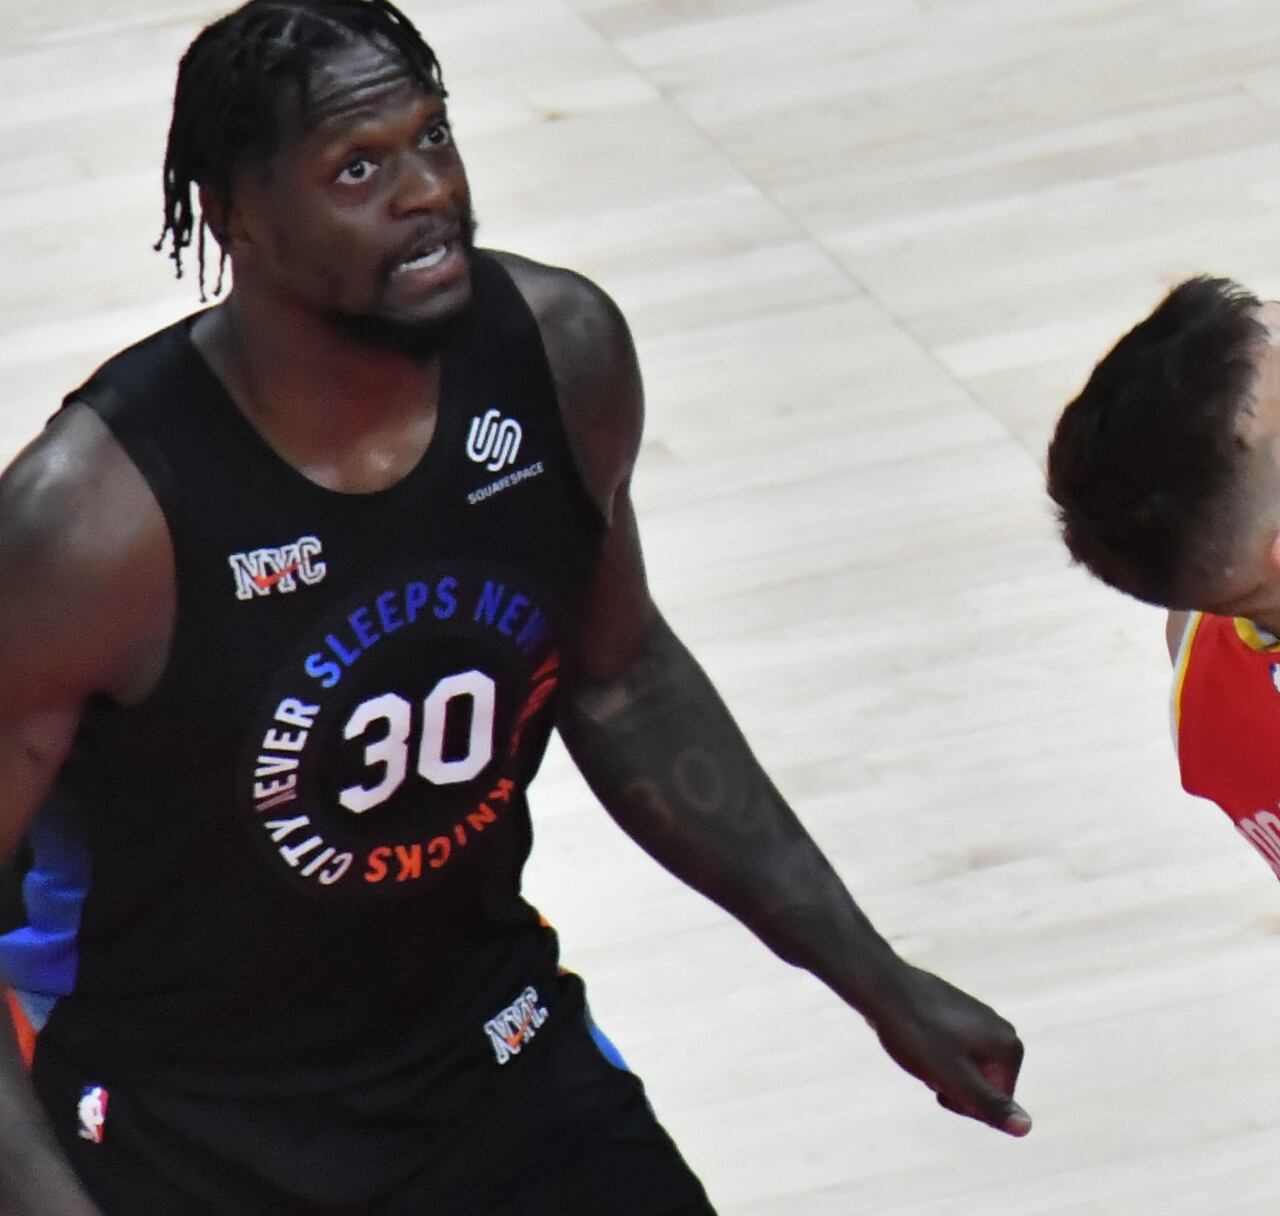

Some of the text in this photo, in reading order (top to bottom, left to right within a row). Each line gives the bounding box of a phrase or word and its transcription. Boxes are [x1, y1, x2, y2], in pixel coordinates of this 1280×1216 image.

[466, 461, 545, 505] SQUARESPACE
[229, 535, 326, 601] NYC
[303, 575, 459, 689] SLEEPS
[337, 667, 497, 815] 30
[262, 813, 354, 886] CITY
[362, 776, 516, 884] KNICKS
